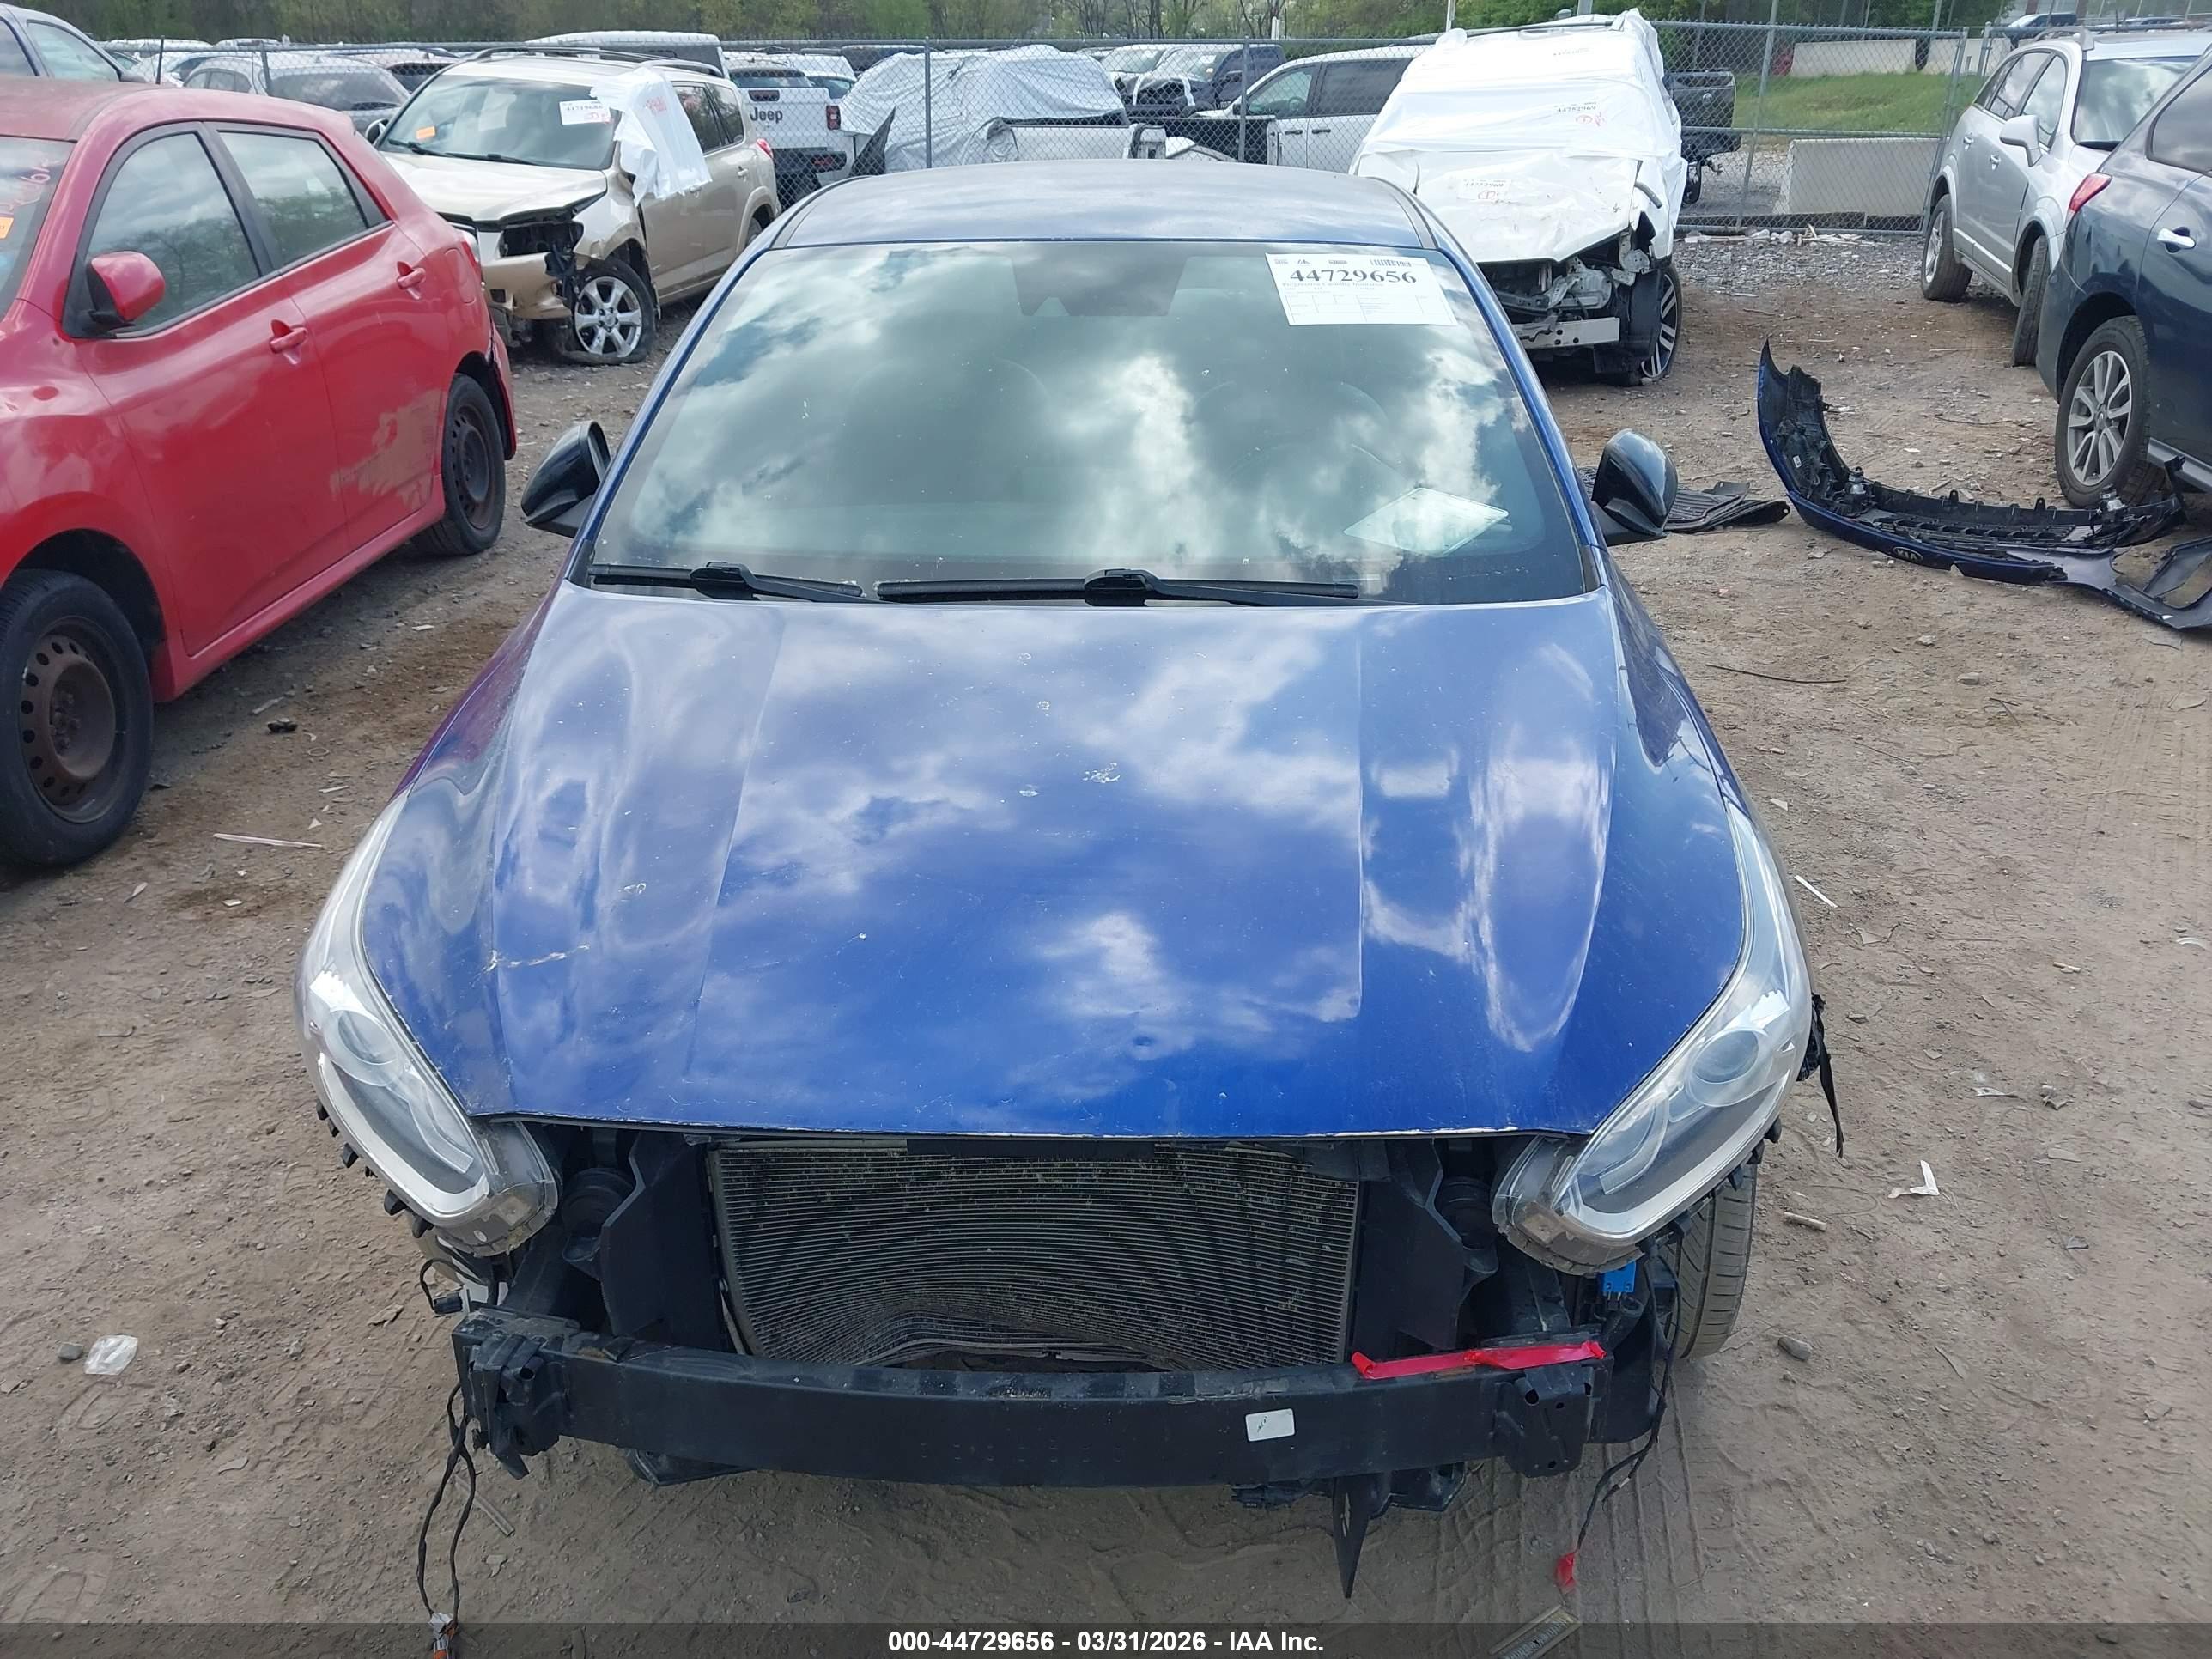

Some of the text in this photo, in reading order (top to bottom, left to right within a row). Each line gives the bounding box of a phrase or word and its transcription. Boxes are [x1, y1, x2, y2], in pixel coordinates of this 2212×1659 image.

[749, 106, 783, 124] Jeep
[1289, 269, 1418, 284] 44729656
[1896, 548, 1919, 562] KIA
